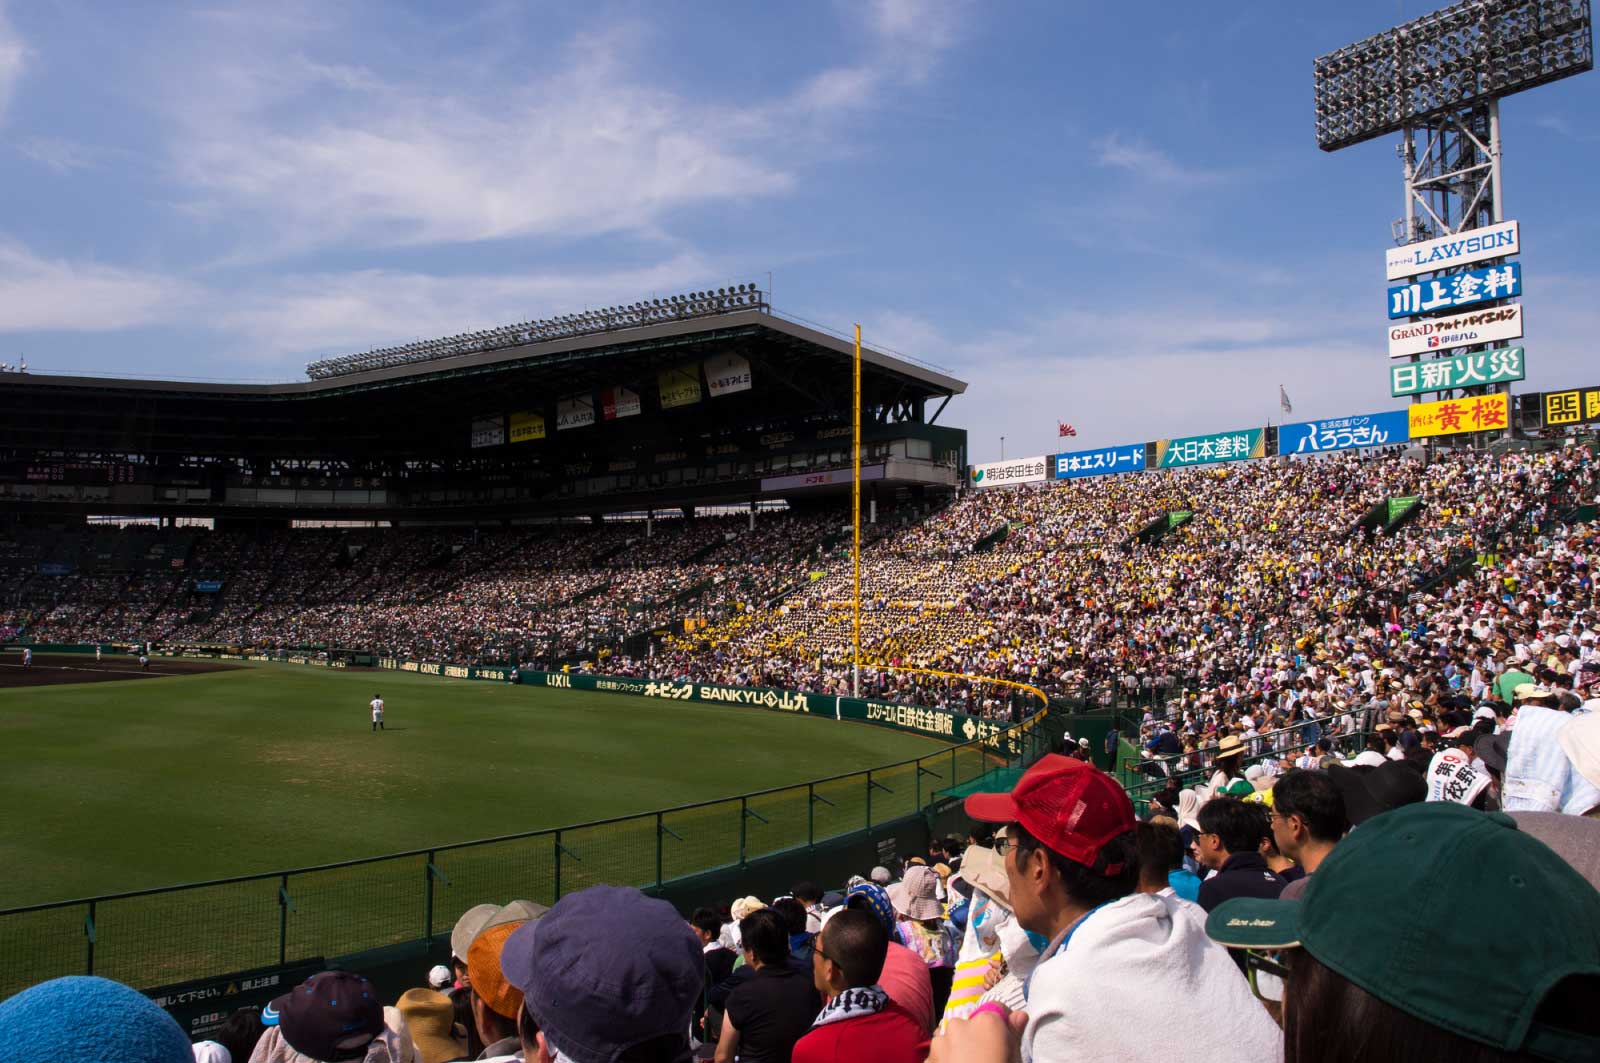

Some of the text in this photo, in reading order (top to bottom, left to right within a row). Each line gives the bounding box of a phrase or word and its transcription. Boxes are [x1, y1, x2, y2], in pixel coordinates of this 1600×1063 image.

[1414, 229, 1513, 265] LAWSON
[1392, 266, 1516, 314] 川上塗料
[1391, 323, 1434, 341] GRAND
[1394, 350, 1520, 393] 日新火災
[1435, 398, 1507, 431] 黄桜
[1168, 434, 1251, 465] 大日本塗料
[1320, 427, 1389, 450] ろうきん
[986, 463, 1045, 480] 明治安田生命
[1057, 449, 1144, 473] 日本エスリード
[420, 662, 441, 675] GUNZE
[547, 673, 572, 688] LIXIL
[644, 683, 692, 700] オービック
[700, 686, 810, 712] SANKYU 山九
